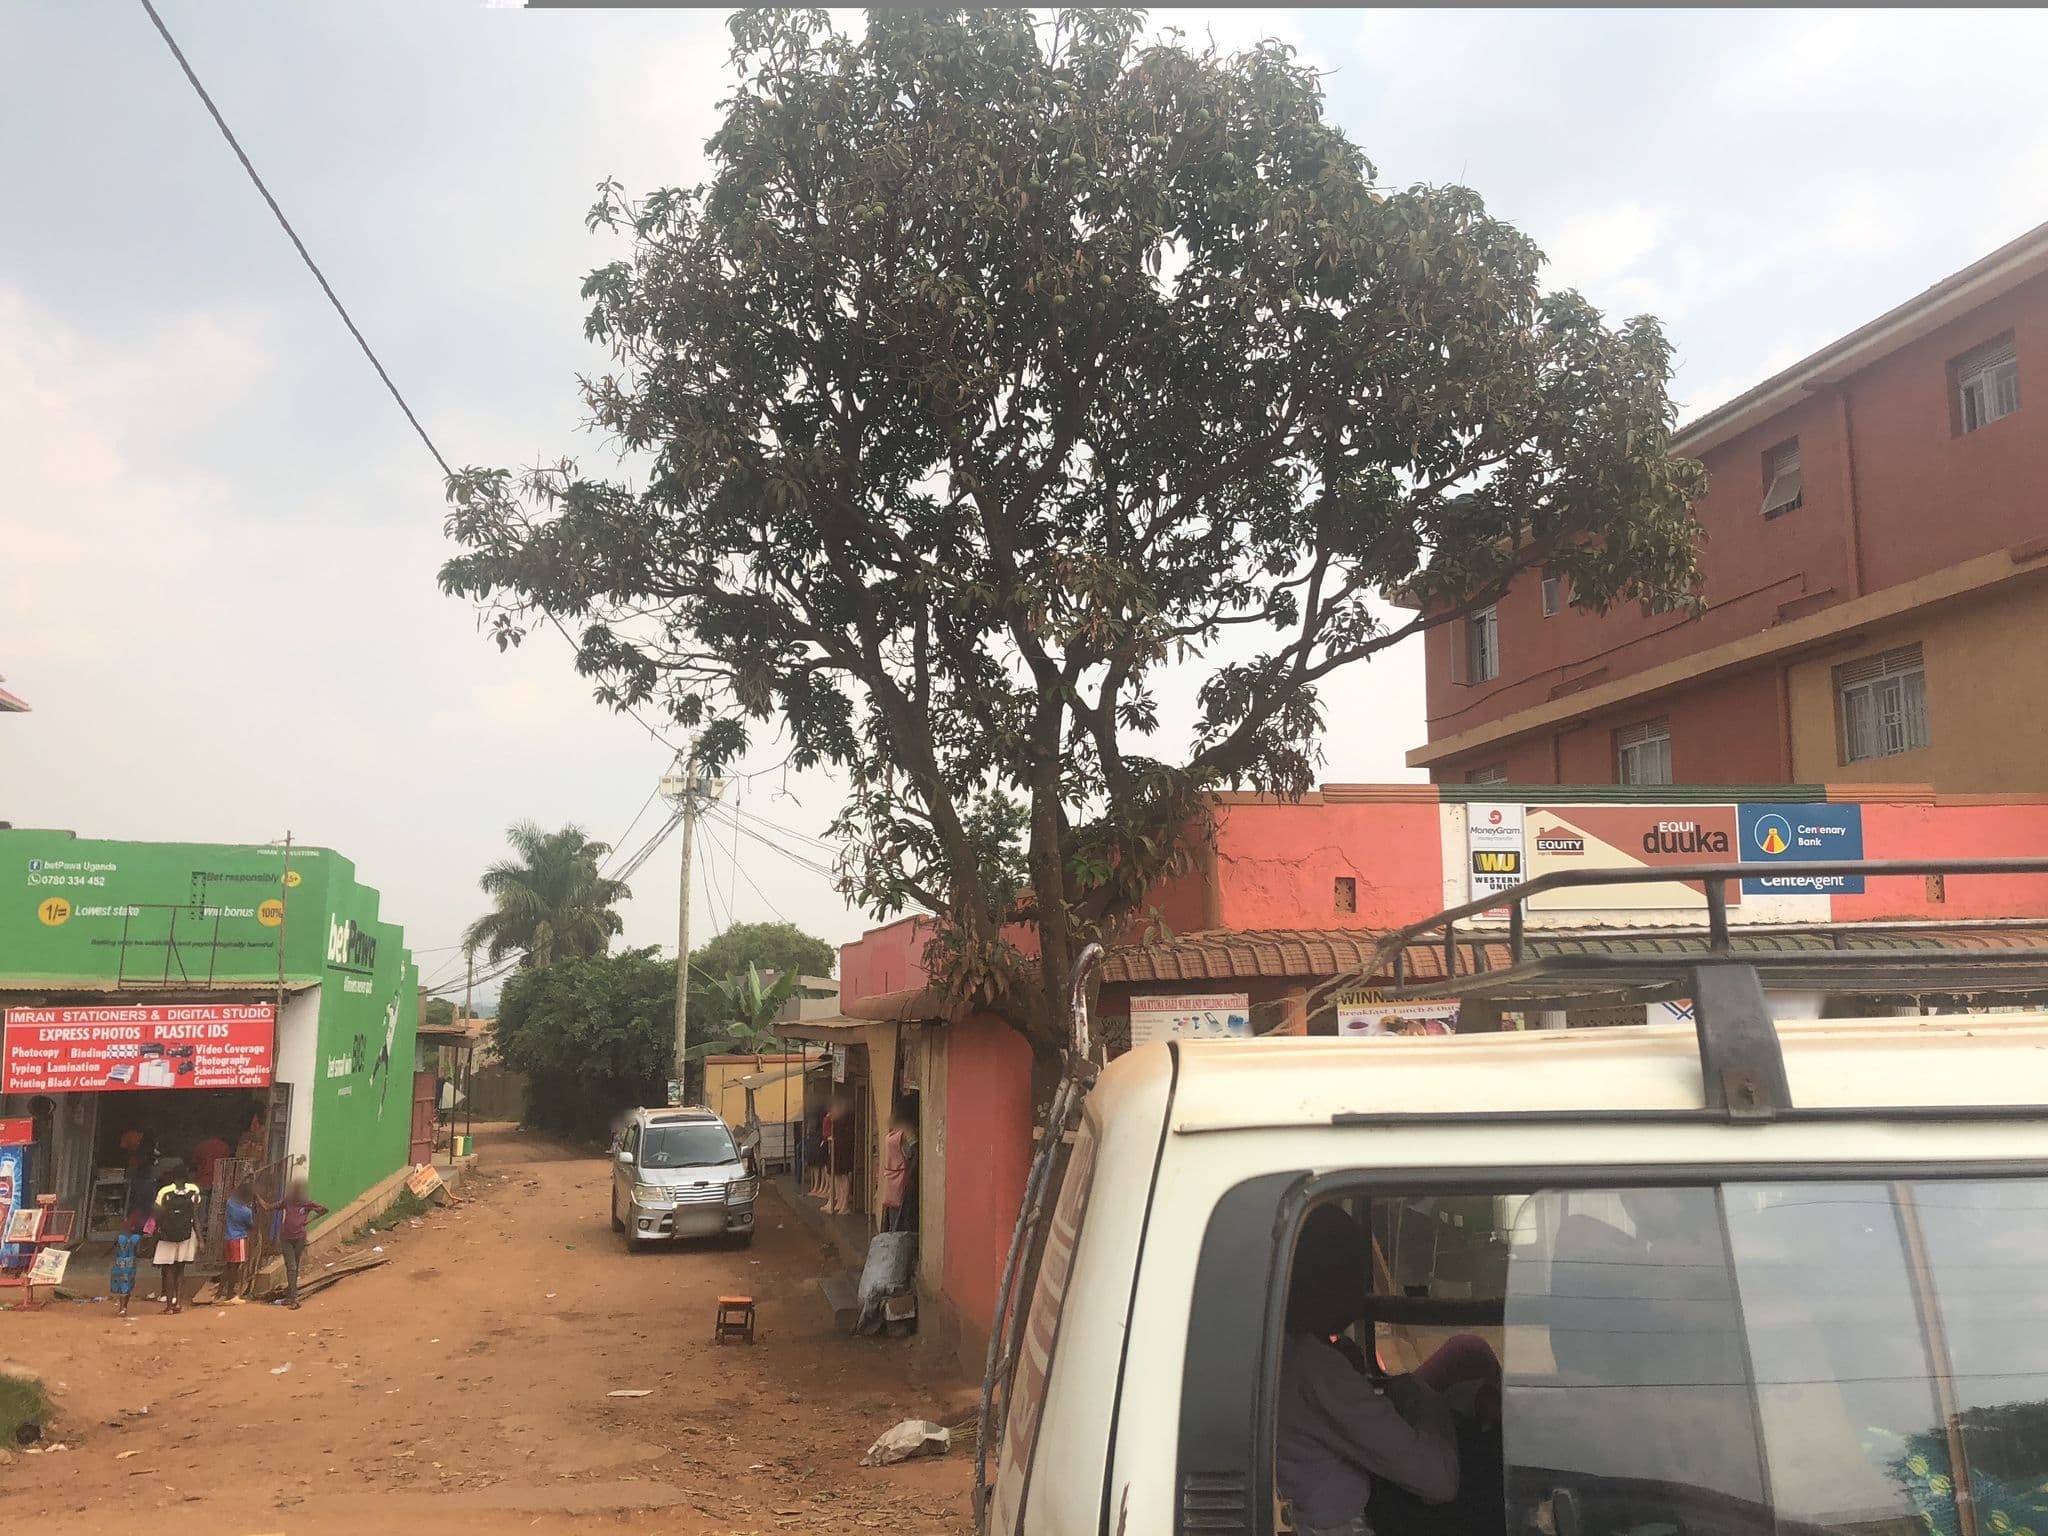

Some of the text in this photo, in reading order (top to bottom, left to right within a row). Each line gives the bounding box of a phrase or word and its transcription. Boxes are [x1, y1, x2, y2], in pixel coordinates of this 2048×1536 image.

[1470, 827, 1520, 836] MoneyGram
[1659, 822, 1693, 833] EQUI
[1797, 825, 1847, 836] Centenary
[1643, 825, 1729, 853] duuka
[1798, 838, 1822, 846] Bank
[1539, 840, 1582, 850] EQUITY
[83, 862, 117, 872] Uganda
[1478, 853, 1516, 872] WU
[41, 876, 65, 885] 0780
[67, 876, 85, 885] 334
[225, 873, 279, 884] responsibly
[1475, 876, 1520, 884] WESTERN
[1761, 876, 1845, 890] CenteAgent
[74, 904, 111, 917] Lowest
[112, 905, 140, 916] stake
[224, 905, 254, 917] bonus
[261, 907, 284, 919] 100%
[1340, 991, 1415, 1006] WINN
[10, 1007, 271, 1023] IMRAN STATIONERS & DIGITAL STUDIO
[39, 1024, 229, 1041] EXPRESS PHOTOS PLASTIC IDS
[12, 1047, 107, 1059] Photocopy Binding
[195, 1043, 265, 1055] Video Coverage
[195, 1056, 251, 1066] Photography
[11, 1062, 100, 1075] Typing Lamination
[237, 1065, 270, 1075] Supplies
[9, 1078, 46, 1089] Printing
[47, 1077, 71, 1087] Black
[79, 1076, 107, 1086] Colour
[239, 1075, 262, 1084] Cards
